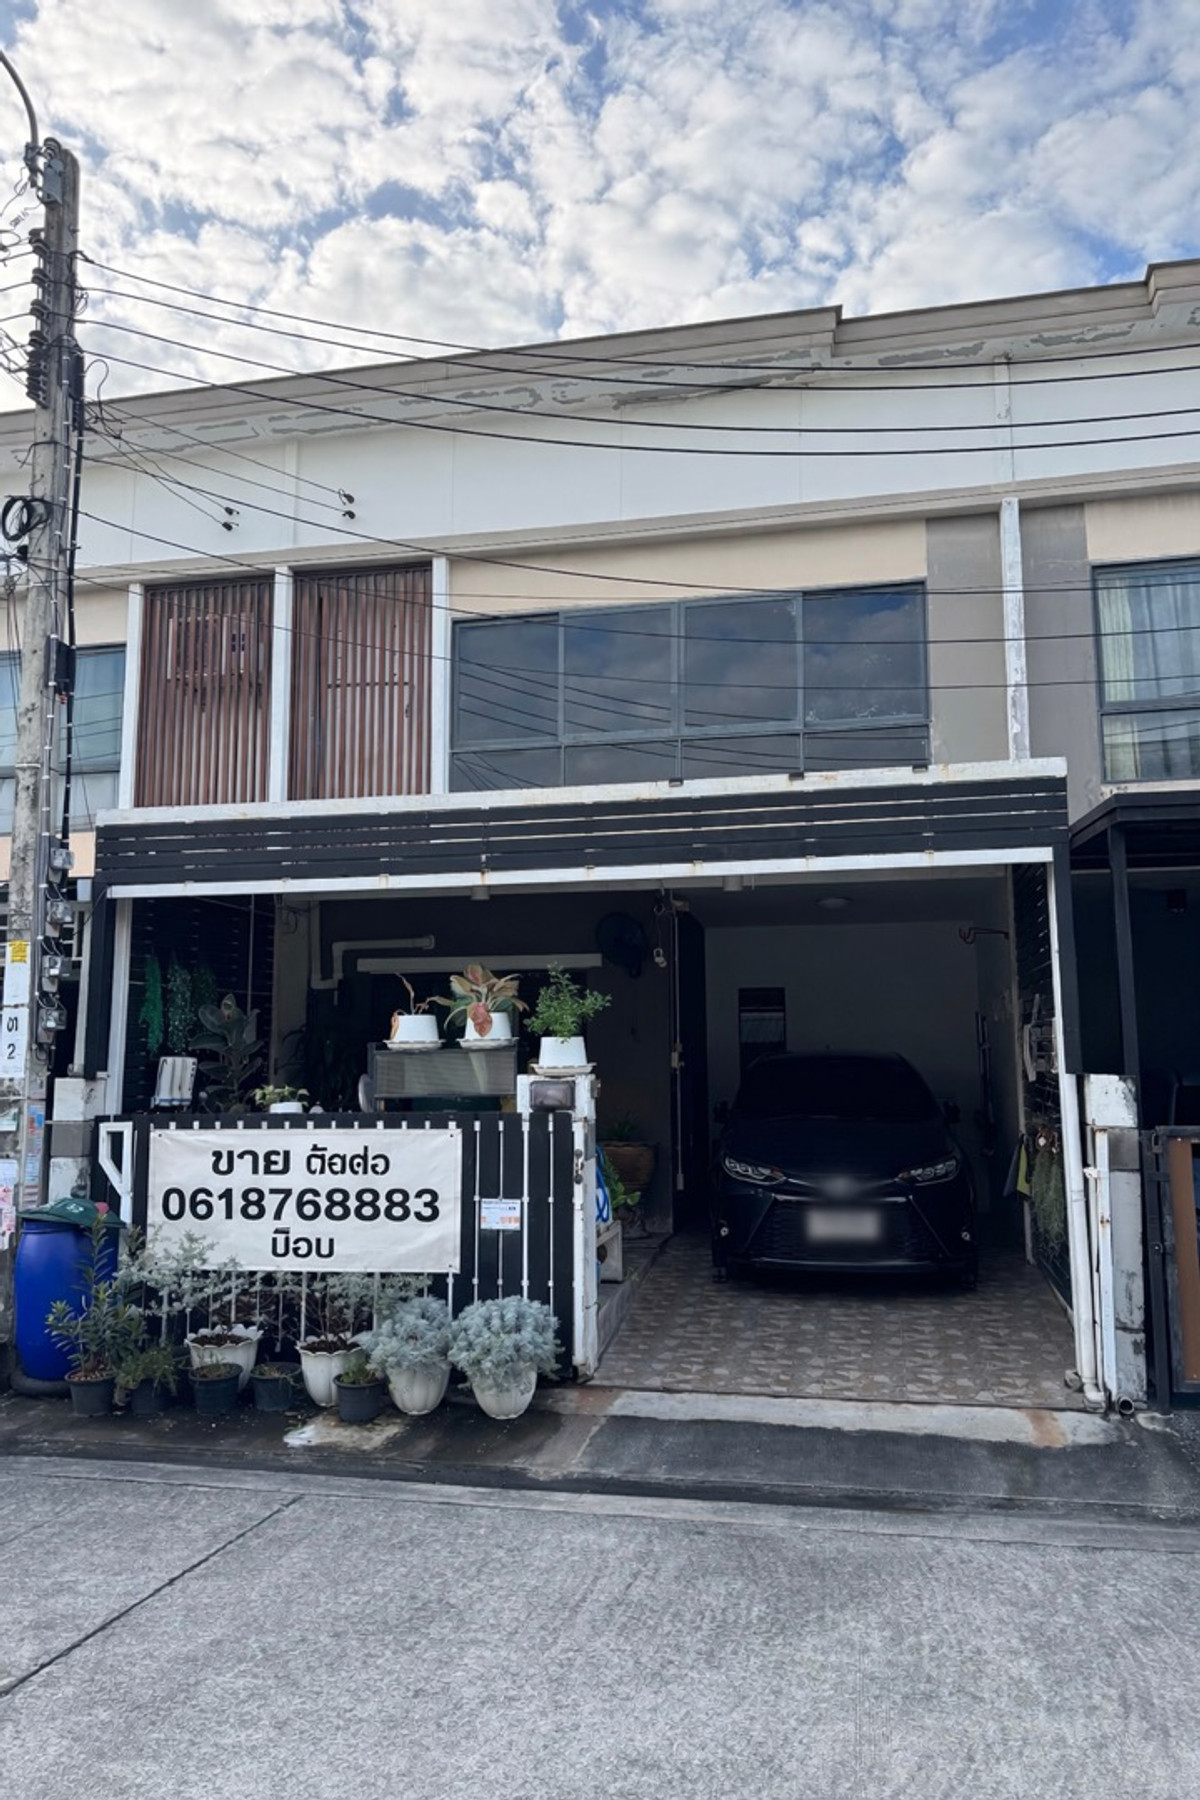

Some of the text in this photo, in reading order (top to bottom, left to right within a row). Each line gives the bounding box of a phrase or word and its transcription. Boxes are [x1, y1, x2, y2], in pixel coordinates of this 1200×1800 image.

[7, 1043, 16, 1059] 2
[211, 1149, 291, 1176] ขาย
[161, 1187, 440, 1223] 0618768883
